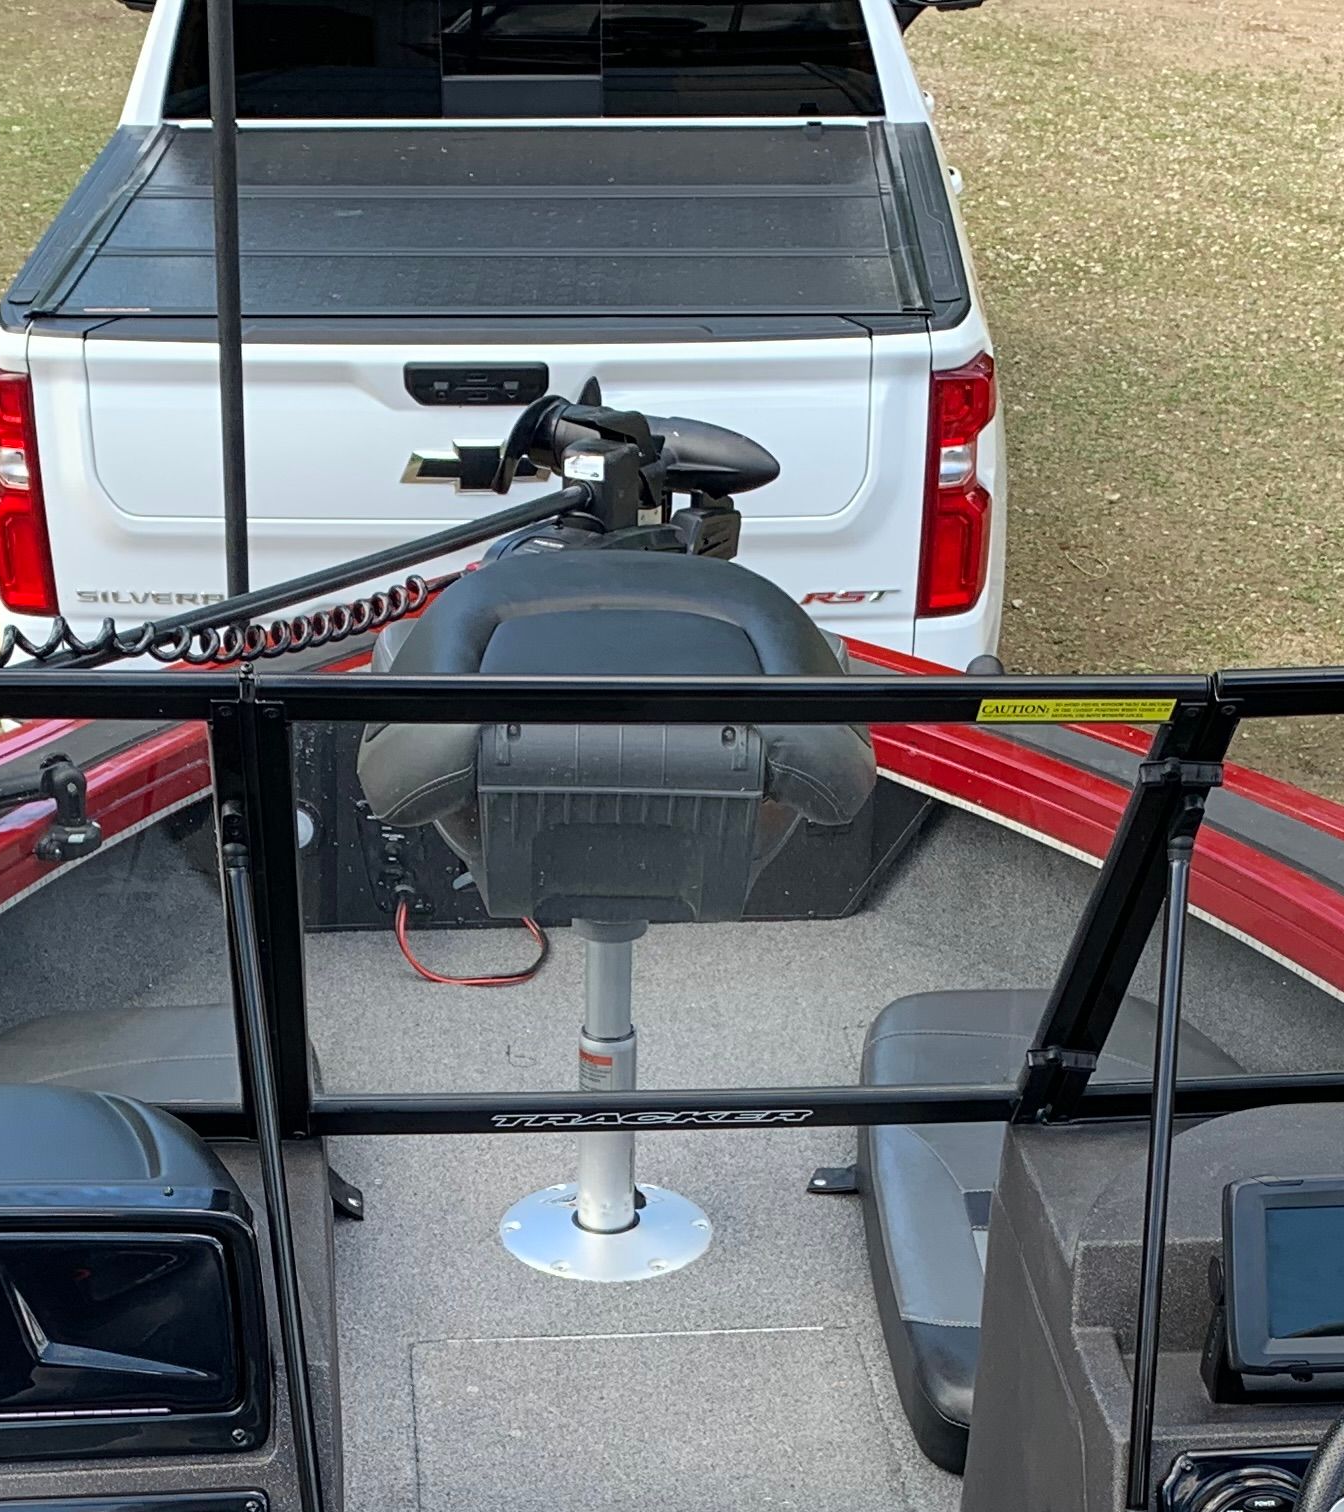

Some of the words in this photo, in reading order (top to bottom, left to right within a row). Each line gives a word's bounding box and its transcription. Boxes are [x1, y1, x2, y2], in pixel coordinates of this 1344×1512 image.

[799, 589, 902, 606] RST
[981, 703, 1050, 714] CAUTION:
[491, 1109, 814, 1127] TRACKER
